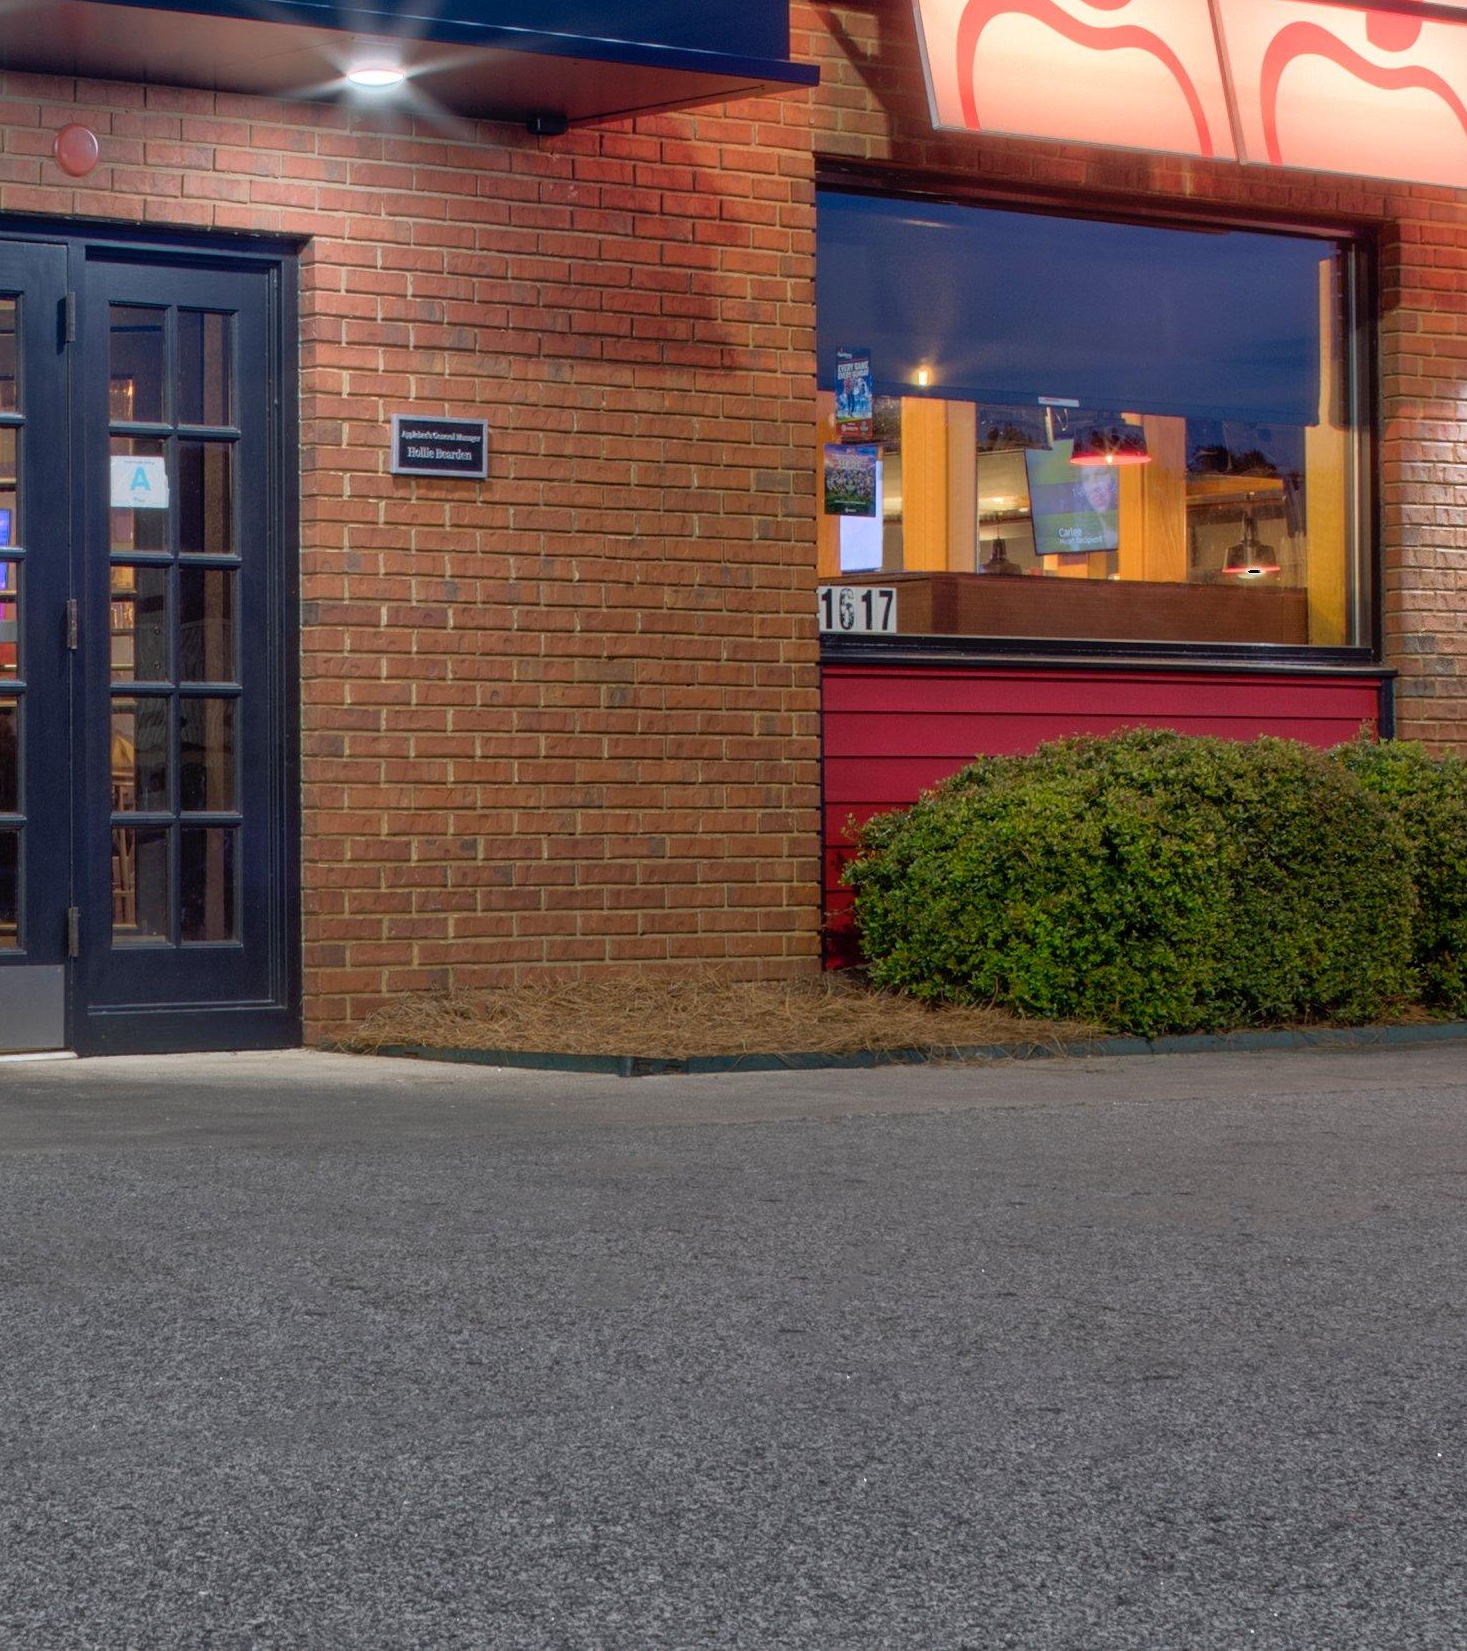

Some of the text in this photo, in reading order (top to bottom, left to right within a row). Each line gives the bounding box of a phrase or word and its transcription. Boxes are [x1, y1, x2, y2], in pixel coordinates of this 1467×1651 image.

[407, 446, 473, 461] Hollie Bearden
[130, 466, 151, 491] A
[821, 588, 894, 631] 1617
